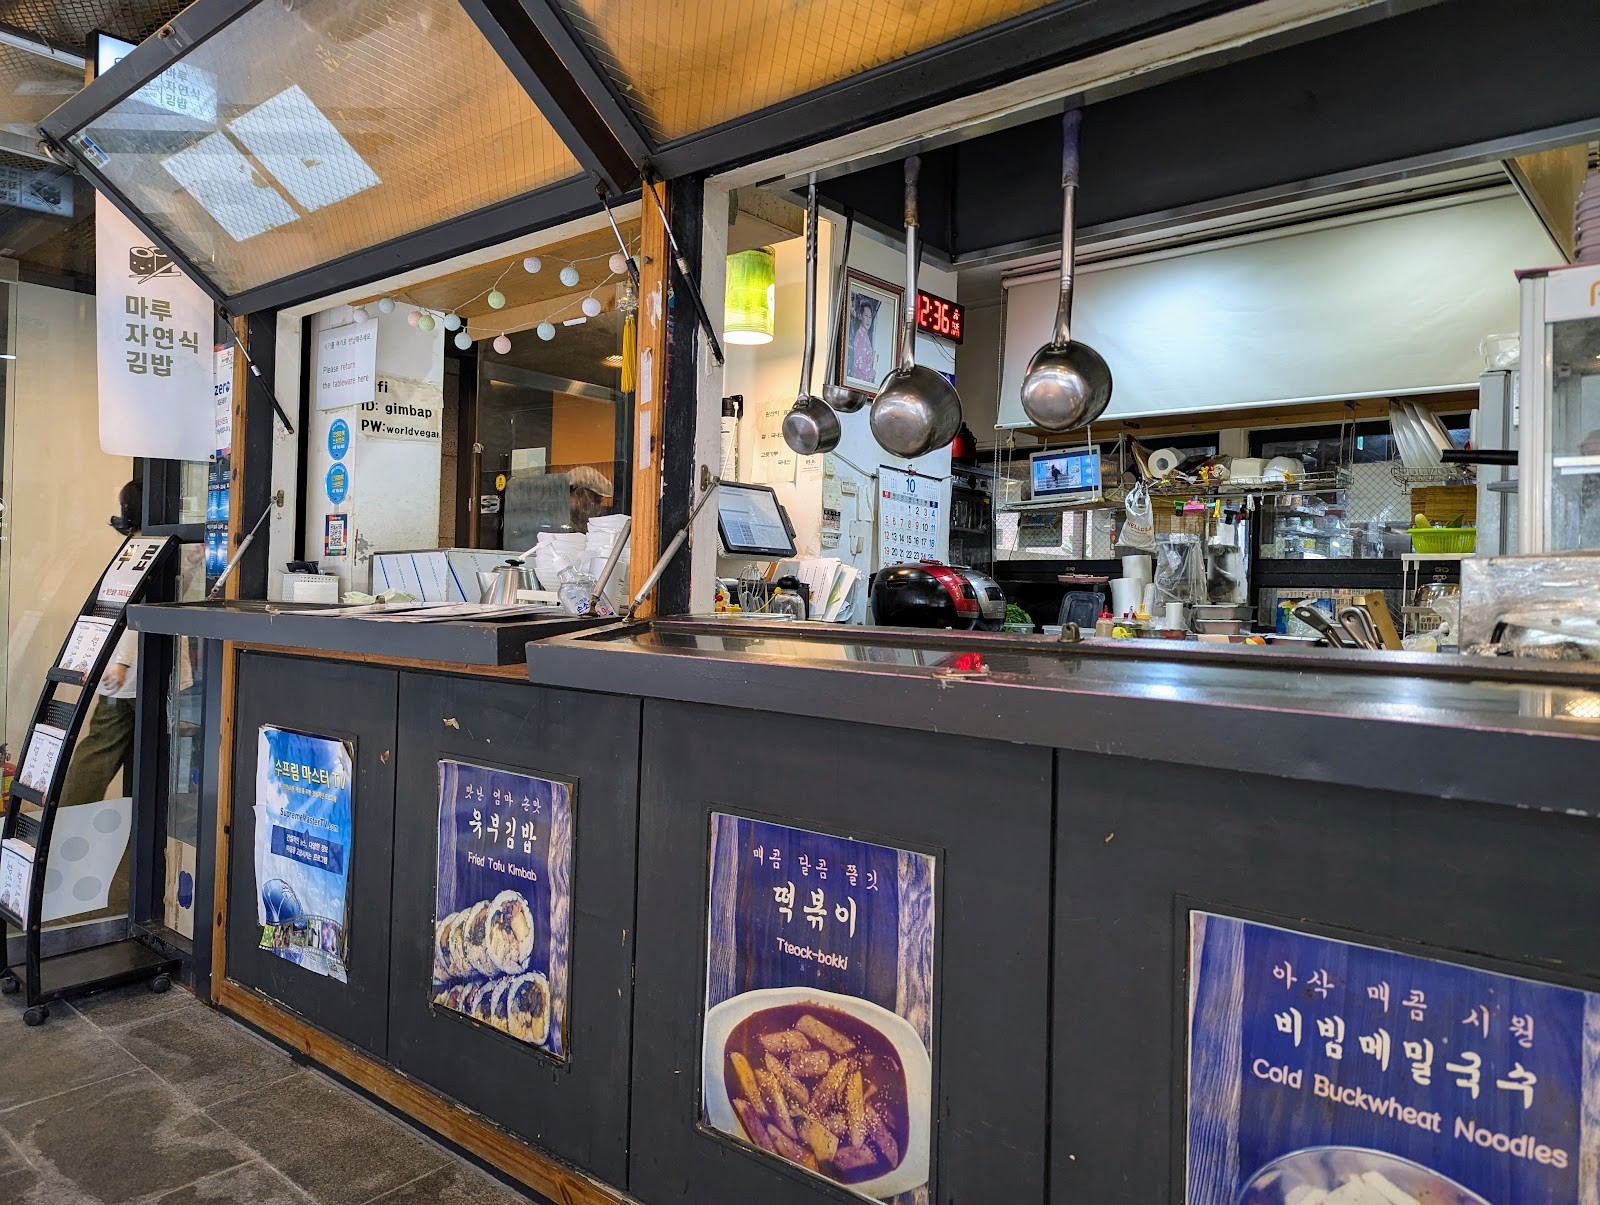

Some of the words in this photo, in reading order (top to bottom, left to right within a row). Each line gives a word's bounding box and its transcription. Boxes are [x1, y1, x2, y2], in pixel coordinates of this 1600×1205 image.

[165, 81, 200, 100] 자연식
[165, 94, 188, 109] 김밥
[126, 295, 172, 322] 마루
[126, 324, 198, 354] 자연식
[126, 350, 173, 377] 김밥
[323, 365, 338, 374] Please
[340, 362, 355, 371] return
[322, 381, 330, 389] the
[332, 378, 355, 388] tableware
[358, 374, 369, 383] here
[385, 403, 432, 418] gimbap
[906, 478, 916, 493] 10
[892, 517, 896, 526] 6
[900, 518, 904, 527] 7
[907, 520, 911, 529] 8
[915, 522, 919, 530] 9
[922, 523, 928, 531] 10
[931, 524, 936, 533] 11
[915, 507, 920, 515] 2
[924, 508, 928, 517] 3
[884, 531, 890, 539] 12
[892, 533, 897, 541] 13
[899, 534, 905, 542] 14
[906, 535, 912, 544] 15
[914, 536, 919, 545] 16
[921, 538, 927, 546] 17
[884, 547, 890, 555] 19
[892, 548, 898, 556] 20
[900, 549, 904, 557] 21
[906, 550, 912, 559] 22
[914, 552, 920, 560] 23
[275, 760, 299, 782] 수프림
[302, 766, 330, 789] 마스터
[332, 772, 346, 790] TV
[493, 789, 514, 807] 엄마
[522, 795, 541, 814] 손맛
[469, 808, 536, 854] 유부김밥
[468, 852, 485, 867] Fried
[488, 857, 505, 872] Tofu
[508, 863, 537, 881] Kimbab
[752, 845, 782, 870] 매콤
[798, 853, 828, 880] 달콤
[772, 880, 857, 938] 떡볶이
[776, 936, 848, 970] Tteock-bokki
[1272, 960, 1334, 999] 아삭
[1366, 981, 1428, 1022] 매콤
[1462, 1004, 1535, 1049] 시원
[1274, 1007, 1537, 1109] 비빔메밀국수
[1252, 1058, 1302, 1090] Cold
[1314, 1073, 1441, 1133] Buckwheat
[1454, 1116, 1568, 1169] Noodles
